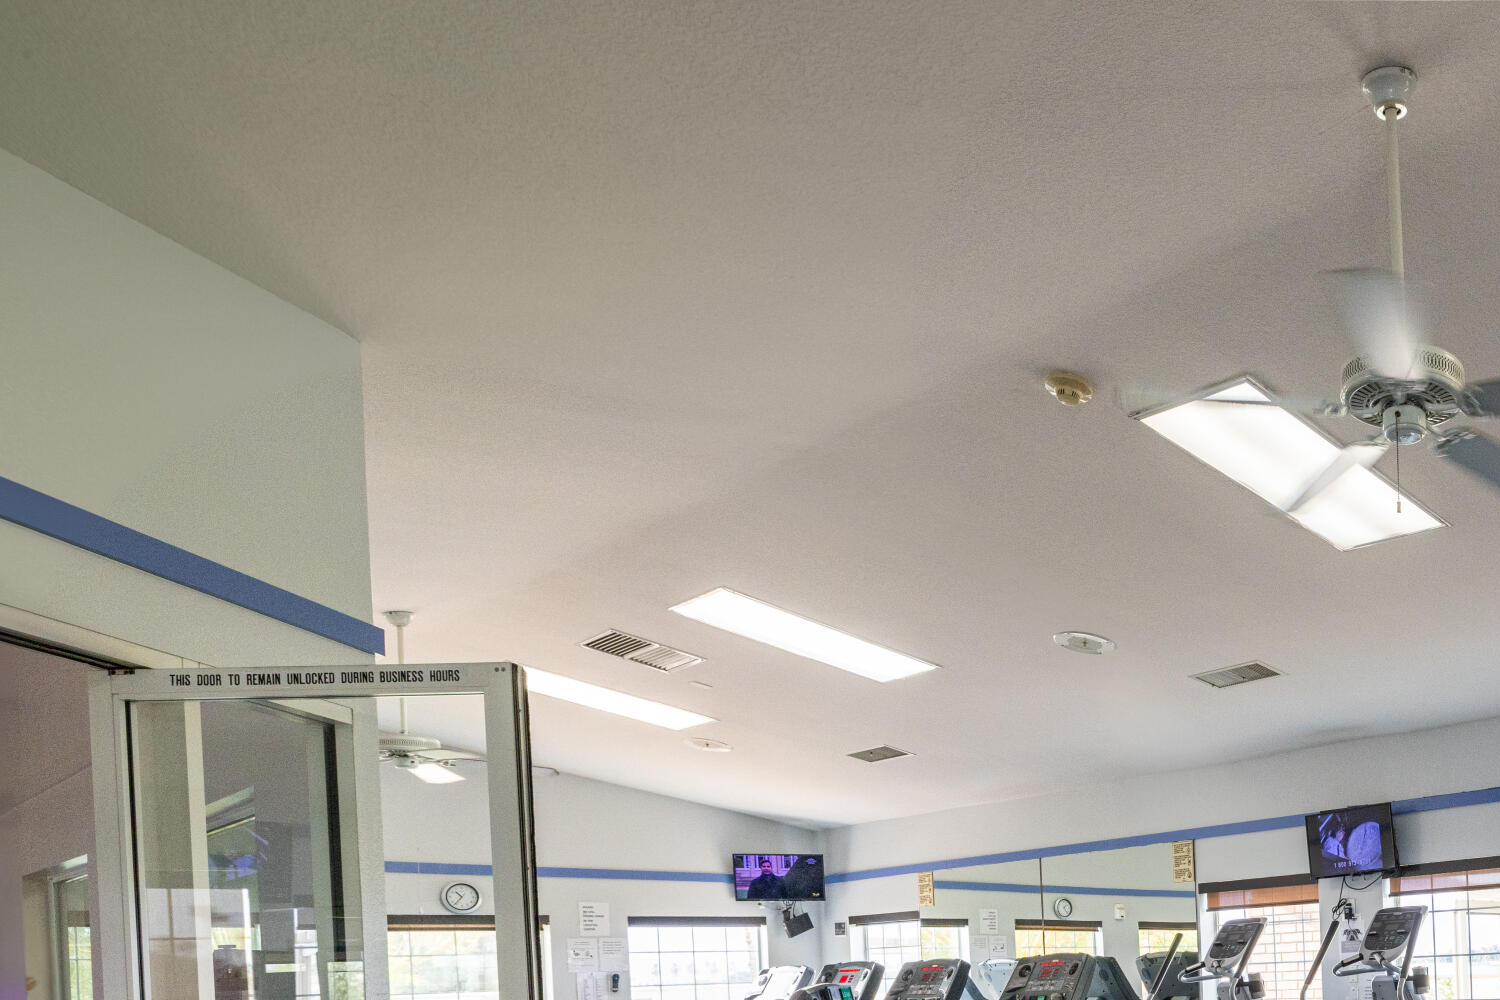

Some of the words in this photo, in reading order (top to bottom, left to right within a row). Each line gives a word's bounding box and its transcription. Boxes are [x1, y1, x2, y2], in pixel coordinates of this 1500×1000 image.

[169, 674, 191, 686] THIS
[197, 674, 222, 686] DOOR
[228, 674, 240, 686] TO
[246, 673, 281, 686] REMAIN
[287, 672, 335, 685] UNLOCKED
[341, 671, 374, 684] DURING
[380, 670, 424, 683] BUSINESS
[430, 670, 460, 682] HOURS
